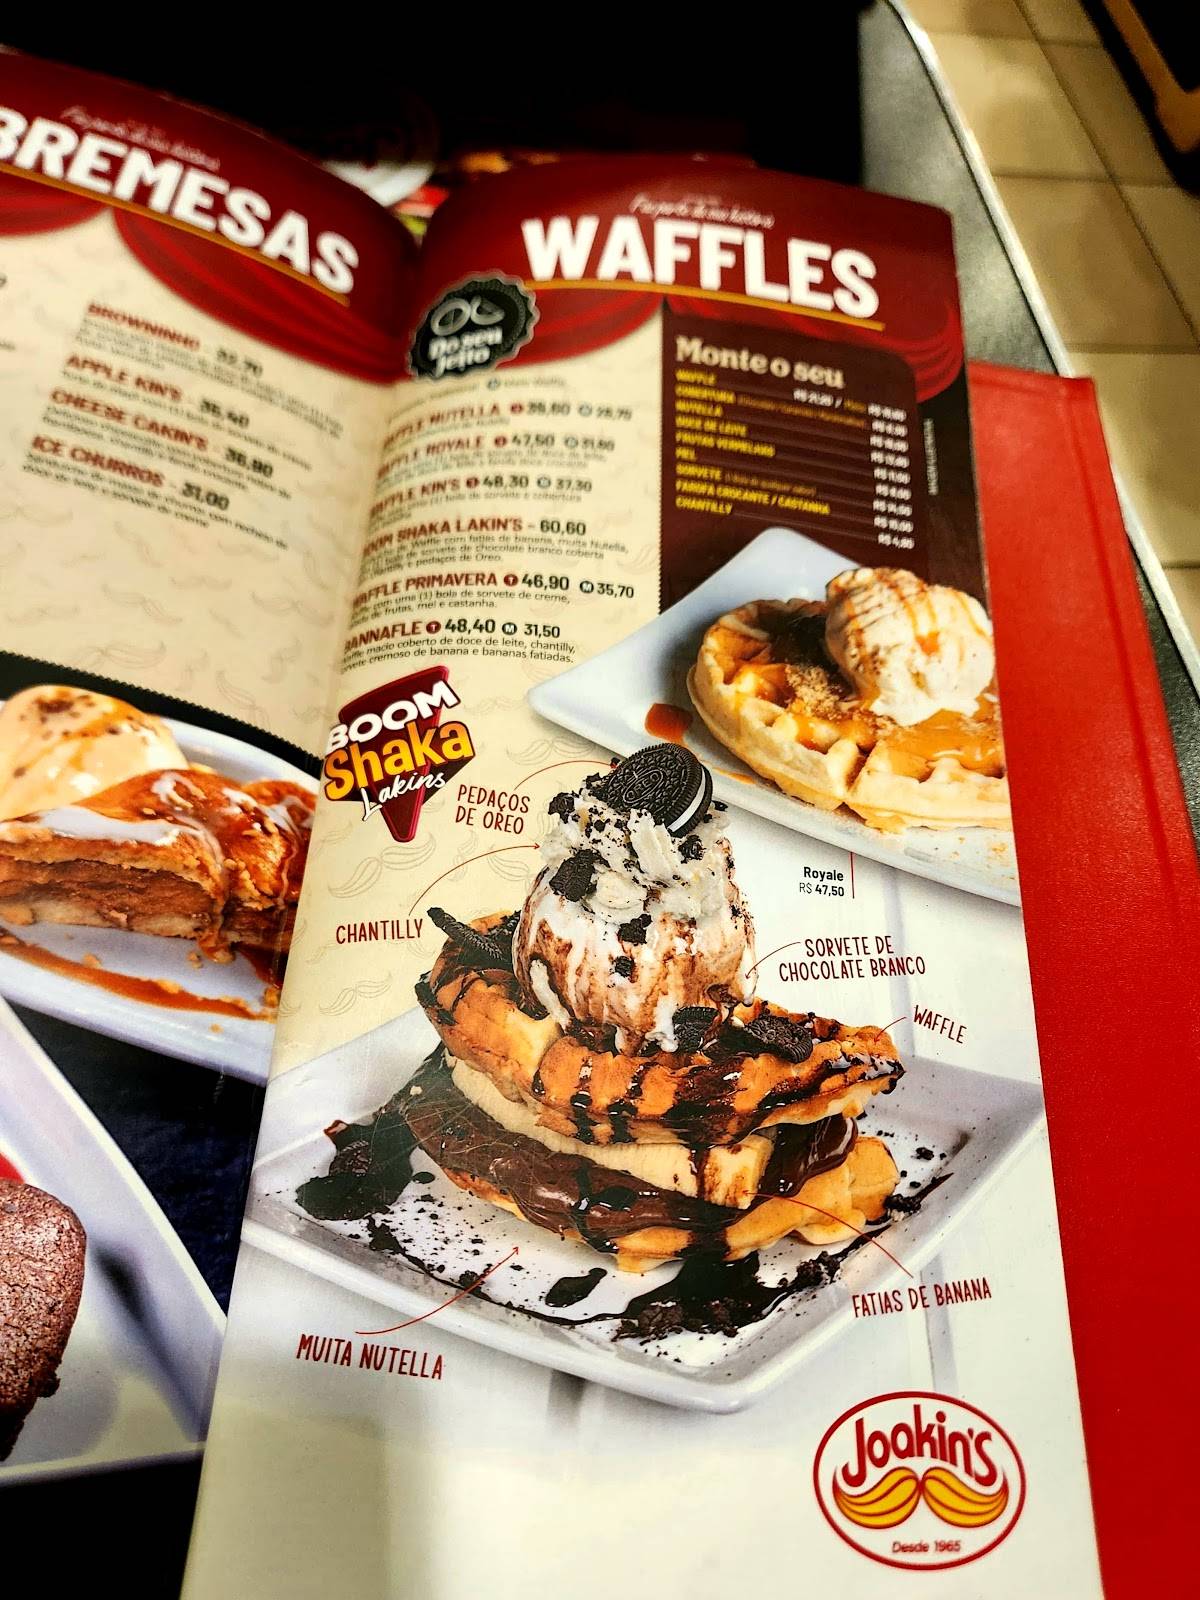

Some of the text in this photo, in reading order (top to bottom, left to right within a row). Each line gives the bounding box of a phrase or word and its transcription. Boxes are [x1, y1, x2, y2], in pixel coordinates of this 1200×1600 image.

[521, 214, 880, 318] WAFFLES
[675, 334, 845, 390] Monte o seu
[31, 434, 63, 456] ICE
[70, 446, 164, 487] CHURROS
[421, 480, 460, 496] KIN'S
[483, 475, 529, 490] 48,30
[675, 495, 733, 515] CHANTILLY
[398, 520, 451, 540] SHAKA
[456, 518, 522, 532] LAKIN'S
[540, 519, 587, 536] 60,60
[405, 572, 498, 591] PRIMAVERA
[522, 573, 570, 591] 46,90
[597, 582, 634, 599] 35,70
[477, 589, 515, 599] sorvete
[534, 593, 570, 605] creme,
[448, 599, 497, 609] castanha.
[445, 619, 496, 635] 48,40
[524, 623, 560, 638] 31,50
[367, 642, 395, 655] macio
[397, 637, 437, 649] coberto
[439, 636, 453, 646] de
[456, 637, 482, 646] doce
[485, 637, 499, 647] de
[502, 637, 527, 649] leite,
[530, 640, 576, 655] chantilly,
[369, 651, 411, 663] cremoso
[413, 648, 427, 656] de
[430, 647, 469, 657] banana
[482, 647, 527, 659] bananas
[530, 650, 574, 664] fatiadas.
[325, 680, 460, 756] BOOM
[325, 721, 475, 801] Shaka
[361, 772, 446, 822] Lakins
[457, 784, 531, 815] PEDAÇOS
[455, 805, 525, 835] DE OREO
[803, 866, 844, 882] Royale
[799, 882, 845, 897] R$ 47,50
[335, 918, 424, 945] CHANTILLY
[804, 935, 895, 958] SORVETE DE
[778, 956, 926, 982] CHOCOLATE BRANCO
[912, 1005, 968, 1045] WAFFLE
[851, 1277, 993, 1318] FATIAS DE BANANA
[296, 1333, 444, 1380] MUITA NUTELLA
[841, 1404, 999, 1488] Joakin's
[892, 1539, 962, 1554] Desde 1965
